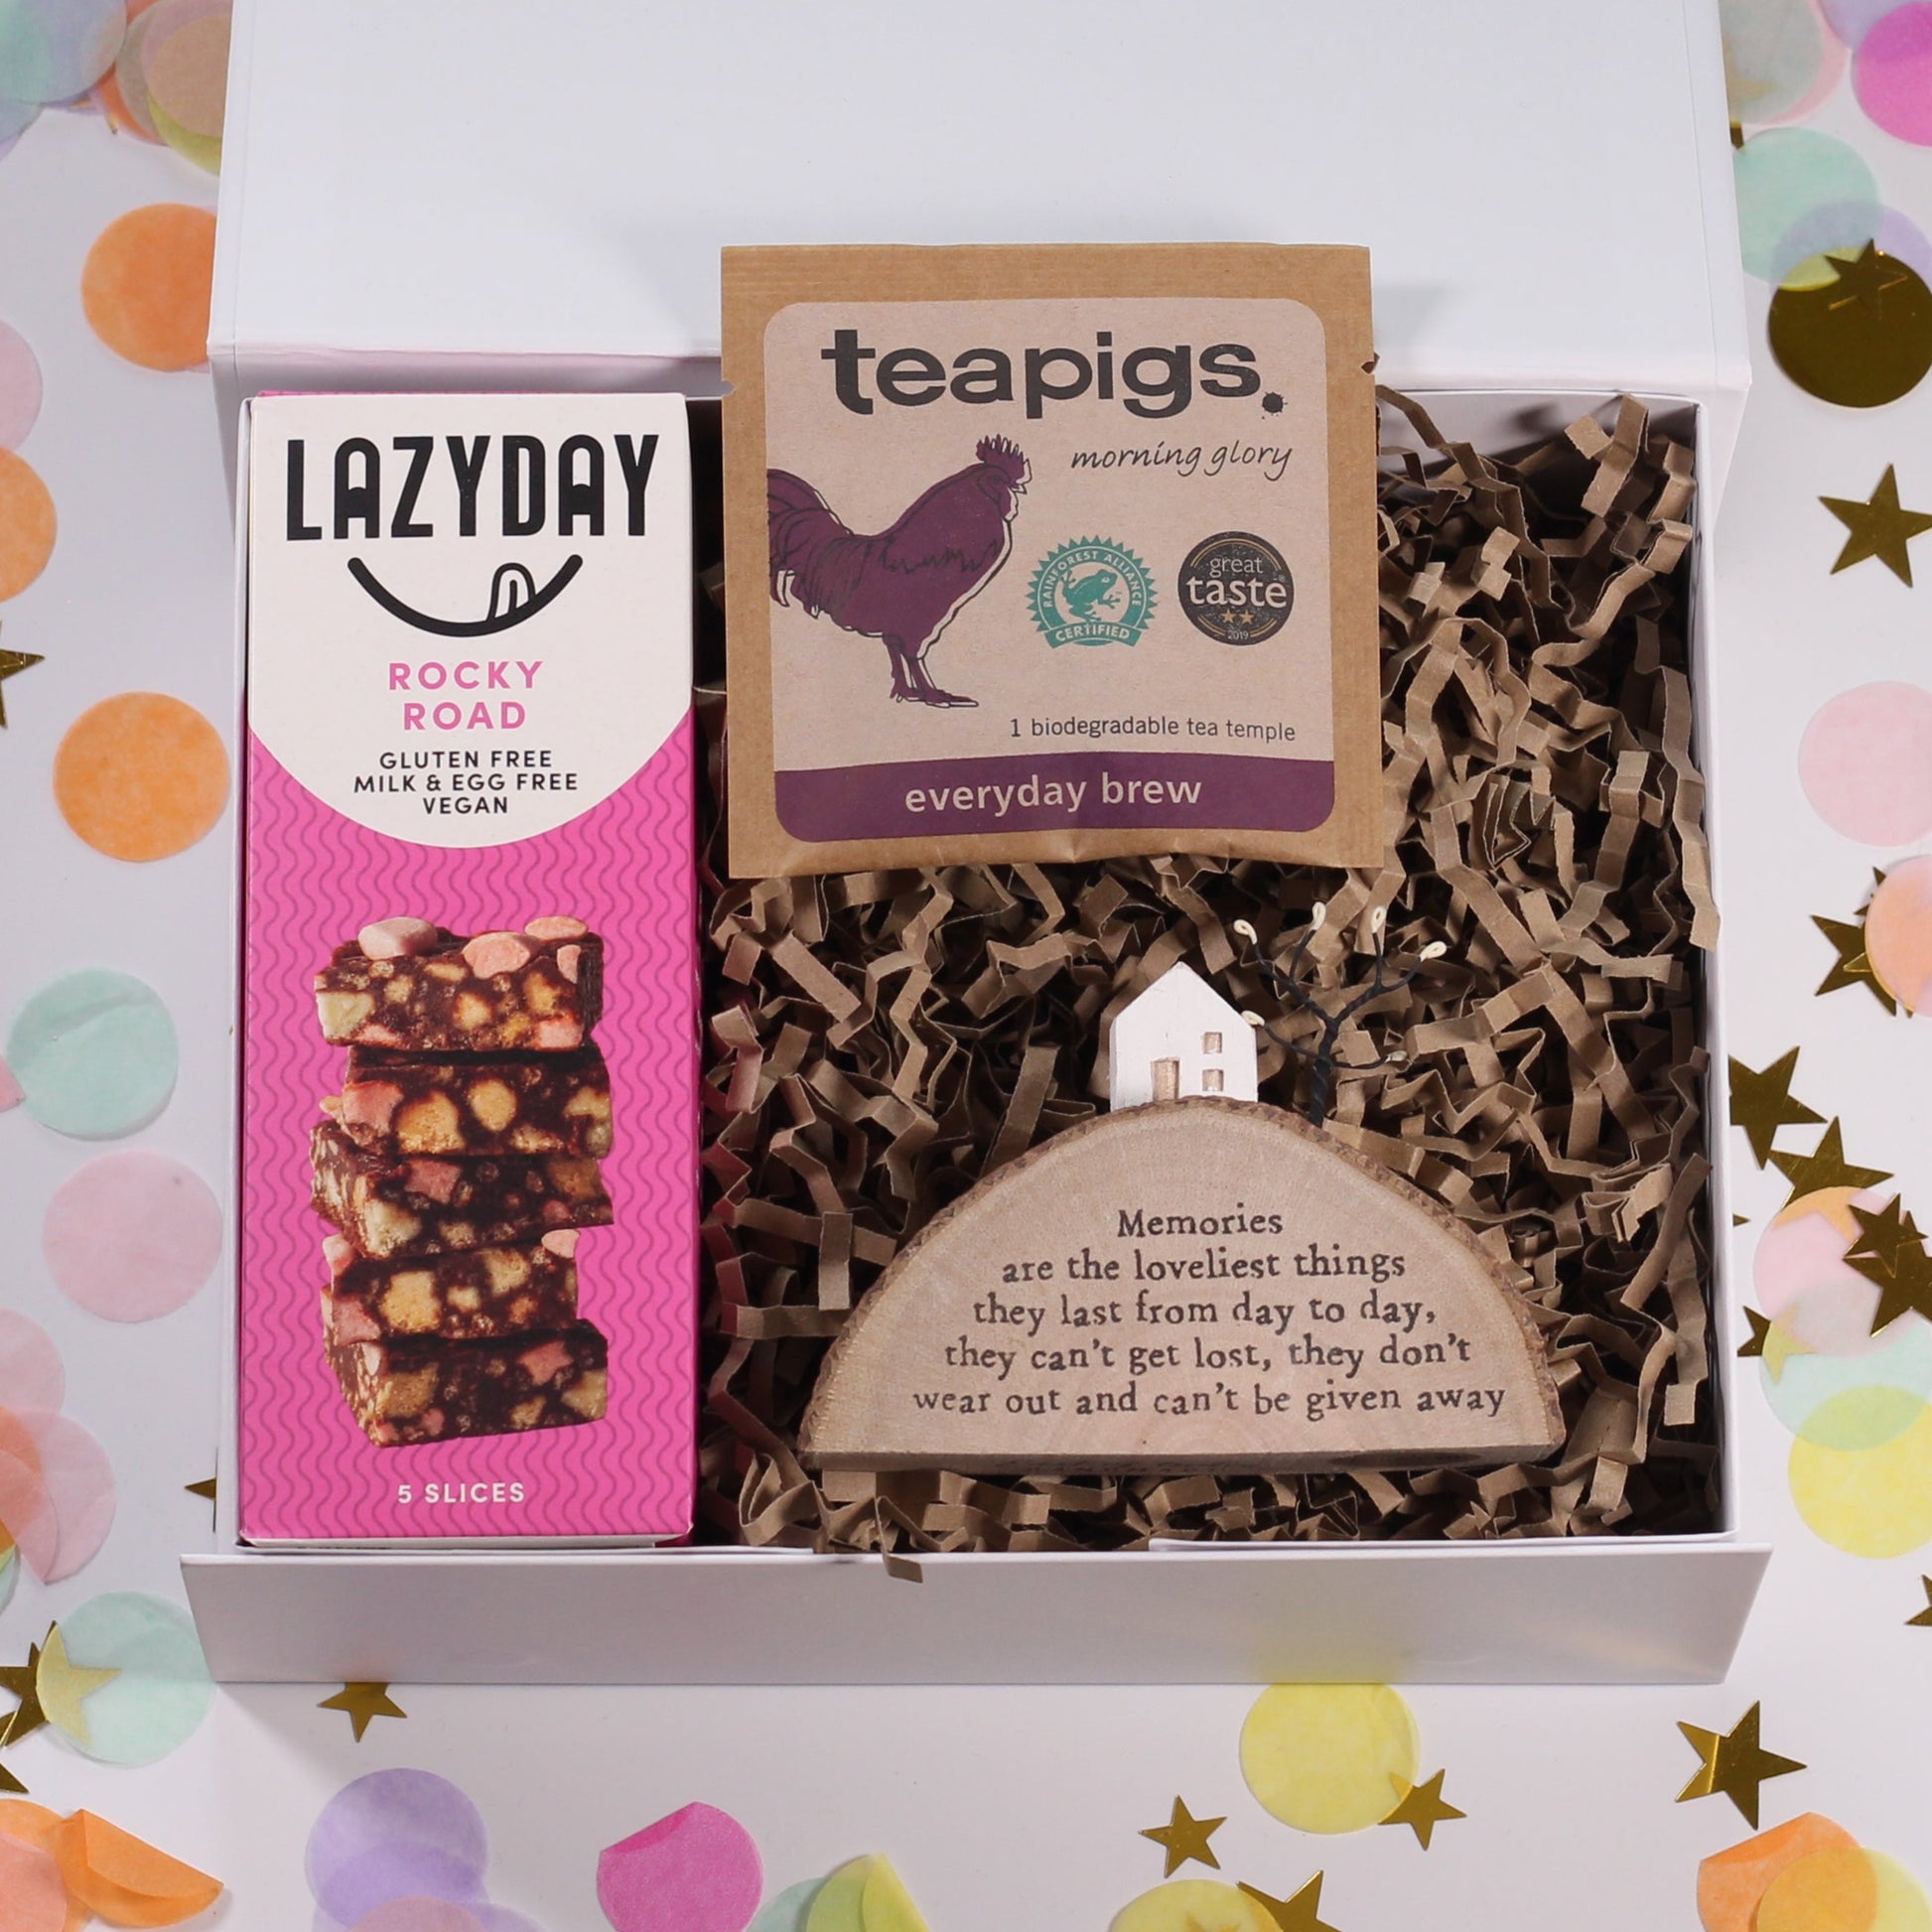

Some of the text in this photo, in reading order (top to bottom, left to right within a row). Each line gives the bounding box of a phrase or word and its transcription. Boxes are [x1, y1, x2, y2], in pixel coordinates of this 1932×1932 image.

[1070, 439, 1294, 483] morning glory
[286, 433, 659, 541] LAZYDAY
[1042, 550, 1142, 609] RAINFOREST ALLIANCE
[1208, 555, 1264, 577] great
[1185, 576, 1288, 609] taste
[1054, 625, 1131, 642] CERTIFIED
[1227, 629, 1249, 640] 2019
[389, 660, 543, 690] ROCKY
[402, 701, 526, 732] ROAD
[1009, 715, 1297, 744] 1 biodegradable tea temple
[378, 749, 553, 770] GLUTEN FREE
[353, 771, 579, 794] MILK & EGG FREE
[904, 772, 1202, 817] everyday brew
[422, 796, 508, 816] VEGAN
[1118, 1202, 1284, 1239] Memories
[1002, 1243, 1407, 1284] are the loveliest things
[973, 1289, 1438, 1335] they last from day to day,
[944, 1335, 1016, 1380] they
[1128, 1342, 1182, 1378] get
[1193, 1337, 1274, 1375] lost,
[1288, 1333, 1365, 1379] they
[912, 1388, 993, 1414] wear
[1005, 1389, 1062, 1415] out
[1075, 1382, 1139, 1413] and
[1253, 1380, 1293, 1415] be
[1306, 1377, 1403, 1422] given
[1416, 1389, 1507, 1420] away
[397, 1482, 526, 1504] 5 SLICES
